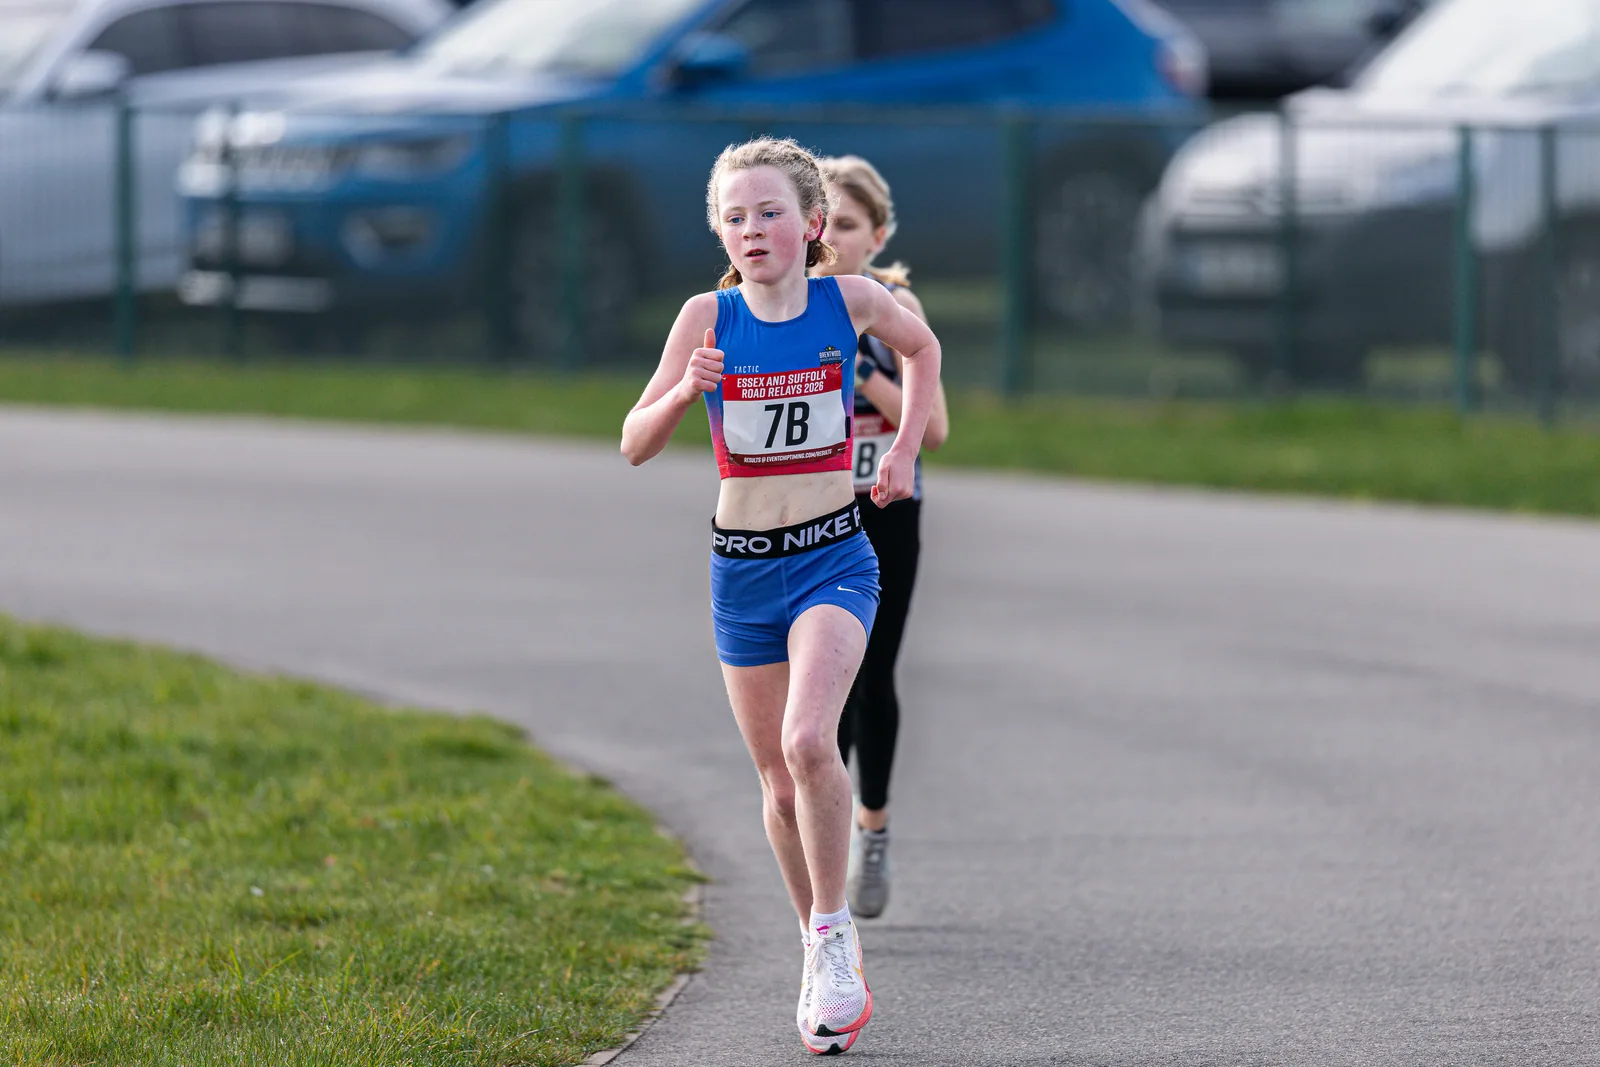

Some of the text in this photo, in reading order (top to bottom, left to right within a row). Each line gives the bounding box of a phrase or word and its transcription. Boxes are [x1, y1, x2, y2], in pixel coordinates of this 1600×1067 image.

[819, 350, 842, 359] BRENTWOOD
[734, 365, 760, 374] TACTIC
[737, 369, 827, 388] ESSEX AND SUFFOLK
[741, 381, 824, 399] ROAD RELAYS 2026
[764, 401, 810, 449] 7B
[712, 531, 772, 554] PRO
[783, 512, 852, 551] NIKE
